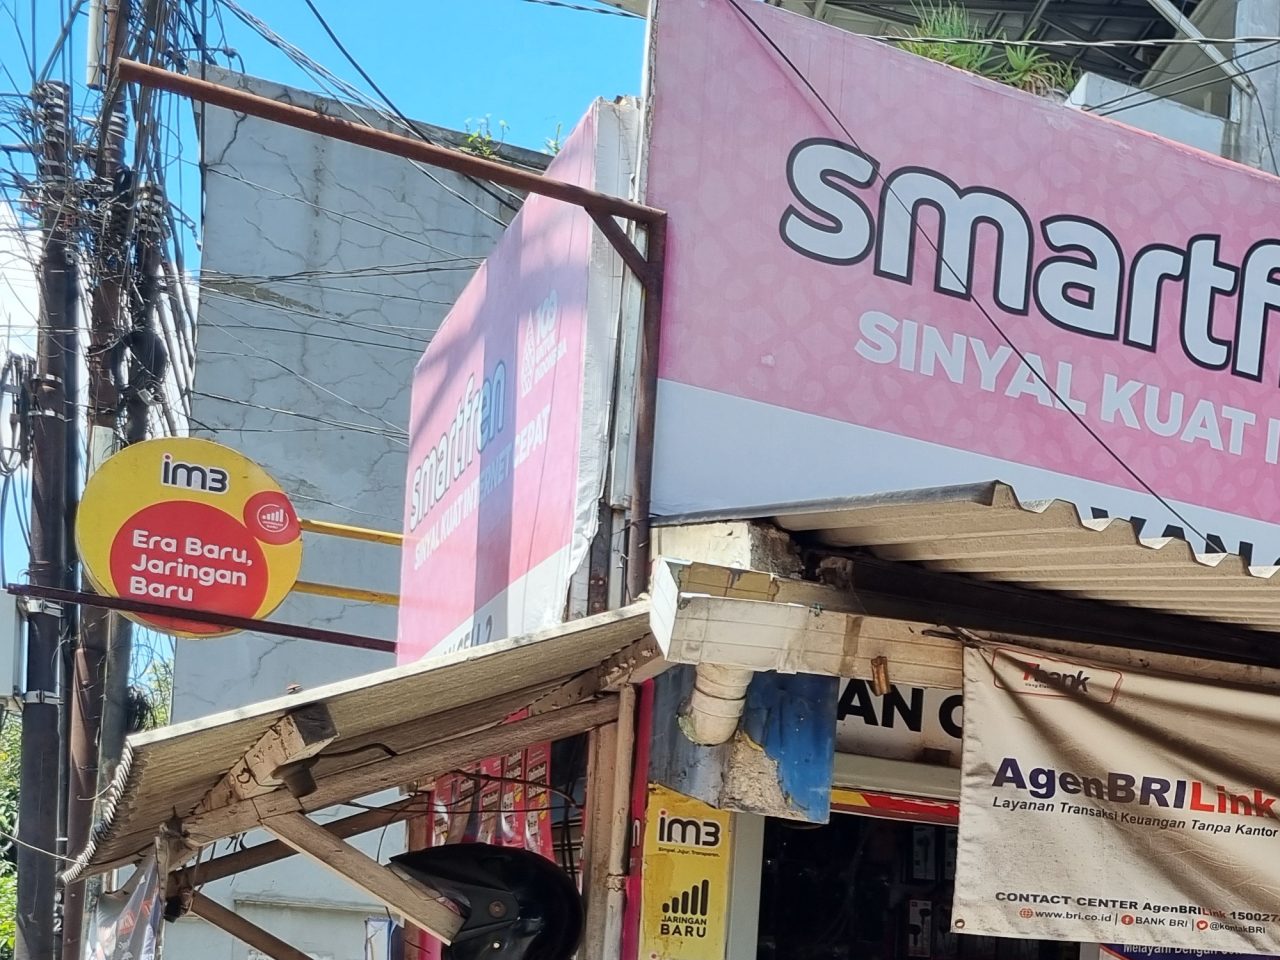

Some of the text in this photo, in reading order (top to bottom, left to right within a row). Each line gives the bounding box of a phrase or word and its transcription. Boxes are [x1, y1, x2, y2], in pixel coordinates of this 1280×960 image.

[854, 311, 1086, 416] SINYAL
[1101, 373, 1256, 455] KUAT
[410, 360, 506, 533] smartfren
[513, 402, 551, 469] CEPAT
[161, 453, 230, 494] im3
[132, 529, 253, 567] Era Baru,
[130, 576, 194, 602] Baru
[131, 553, 247, 587] Jaringan
[836, 678, 924, 732] AN
[992, 757, 1278, 818] AgenBRILink
[657, 809, 721, 847] im3
[992, 796, 1279, 838] Layanan Transaksi Keuangan Tanpa Kantor
[995, 891, 1071, 905] CONTACT
[1076, 897, 1138, 910] CENTER
[1035, 909, 1111, 922] www.bri.co.id
[1135, 916, 1166, 927] BANK
[1169, 918, 1188, 928] BRI
[660, 923, 707, 938] BARU
[661, 915, 707, 925] JARINGAN
